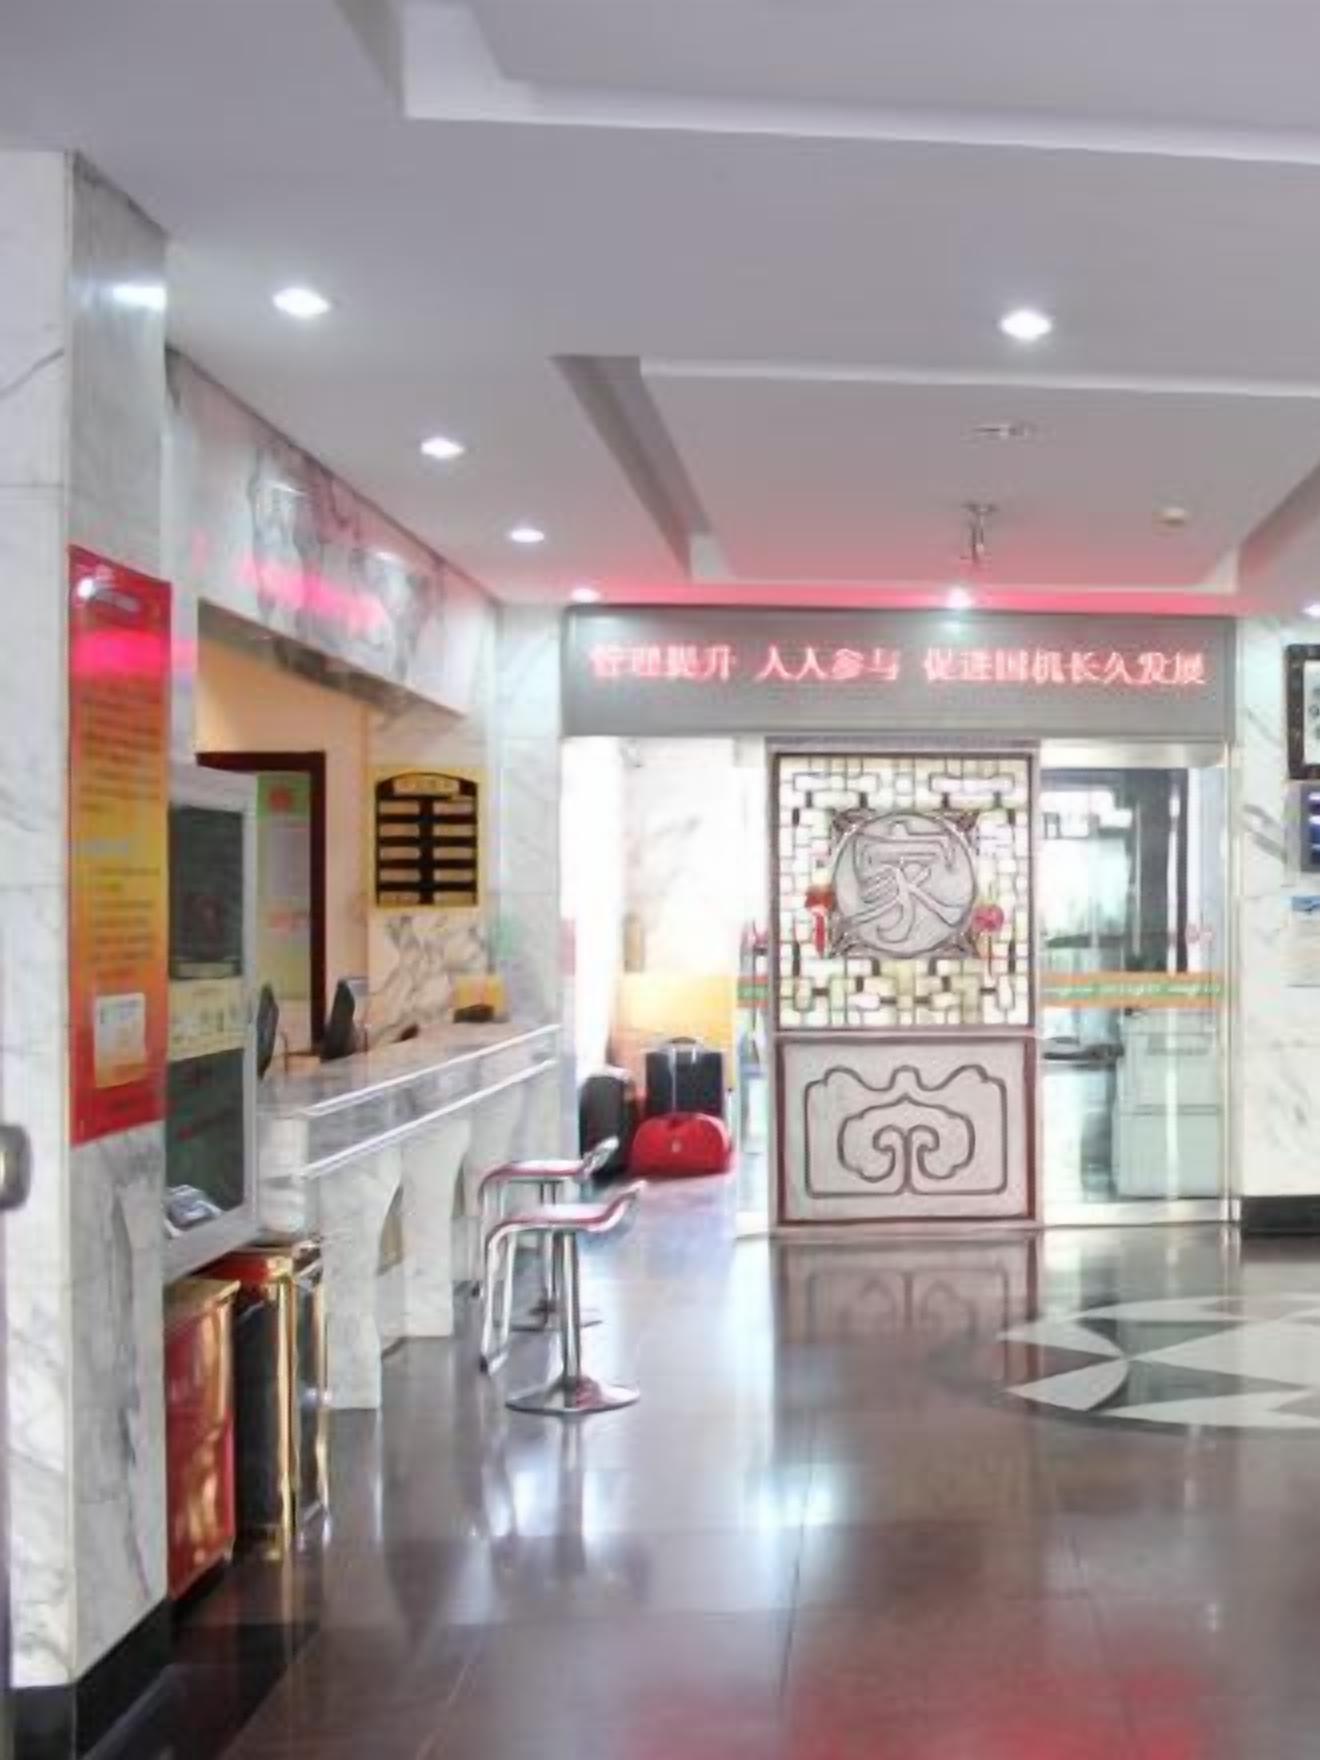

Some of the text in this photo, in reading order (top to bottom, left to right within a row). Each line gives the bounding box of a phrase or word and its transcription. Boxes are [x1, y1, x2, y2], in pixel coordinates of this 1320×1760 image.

[754, 645, 899, 682] 人人参与
[923, 648, 1206, 685] 促进国机长久发展
